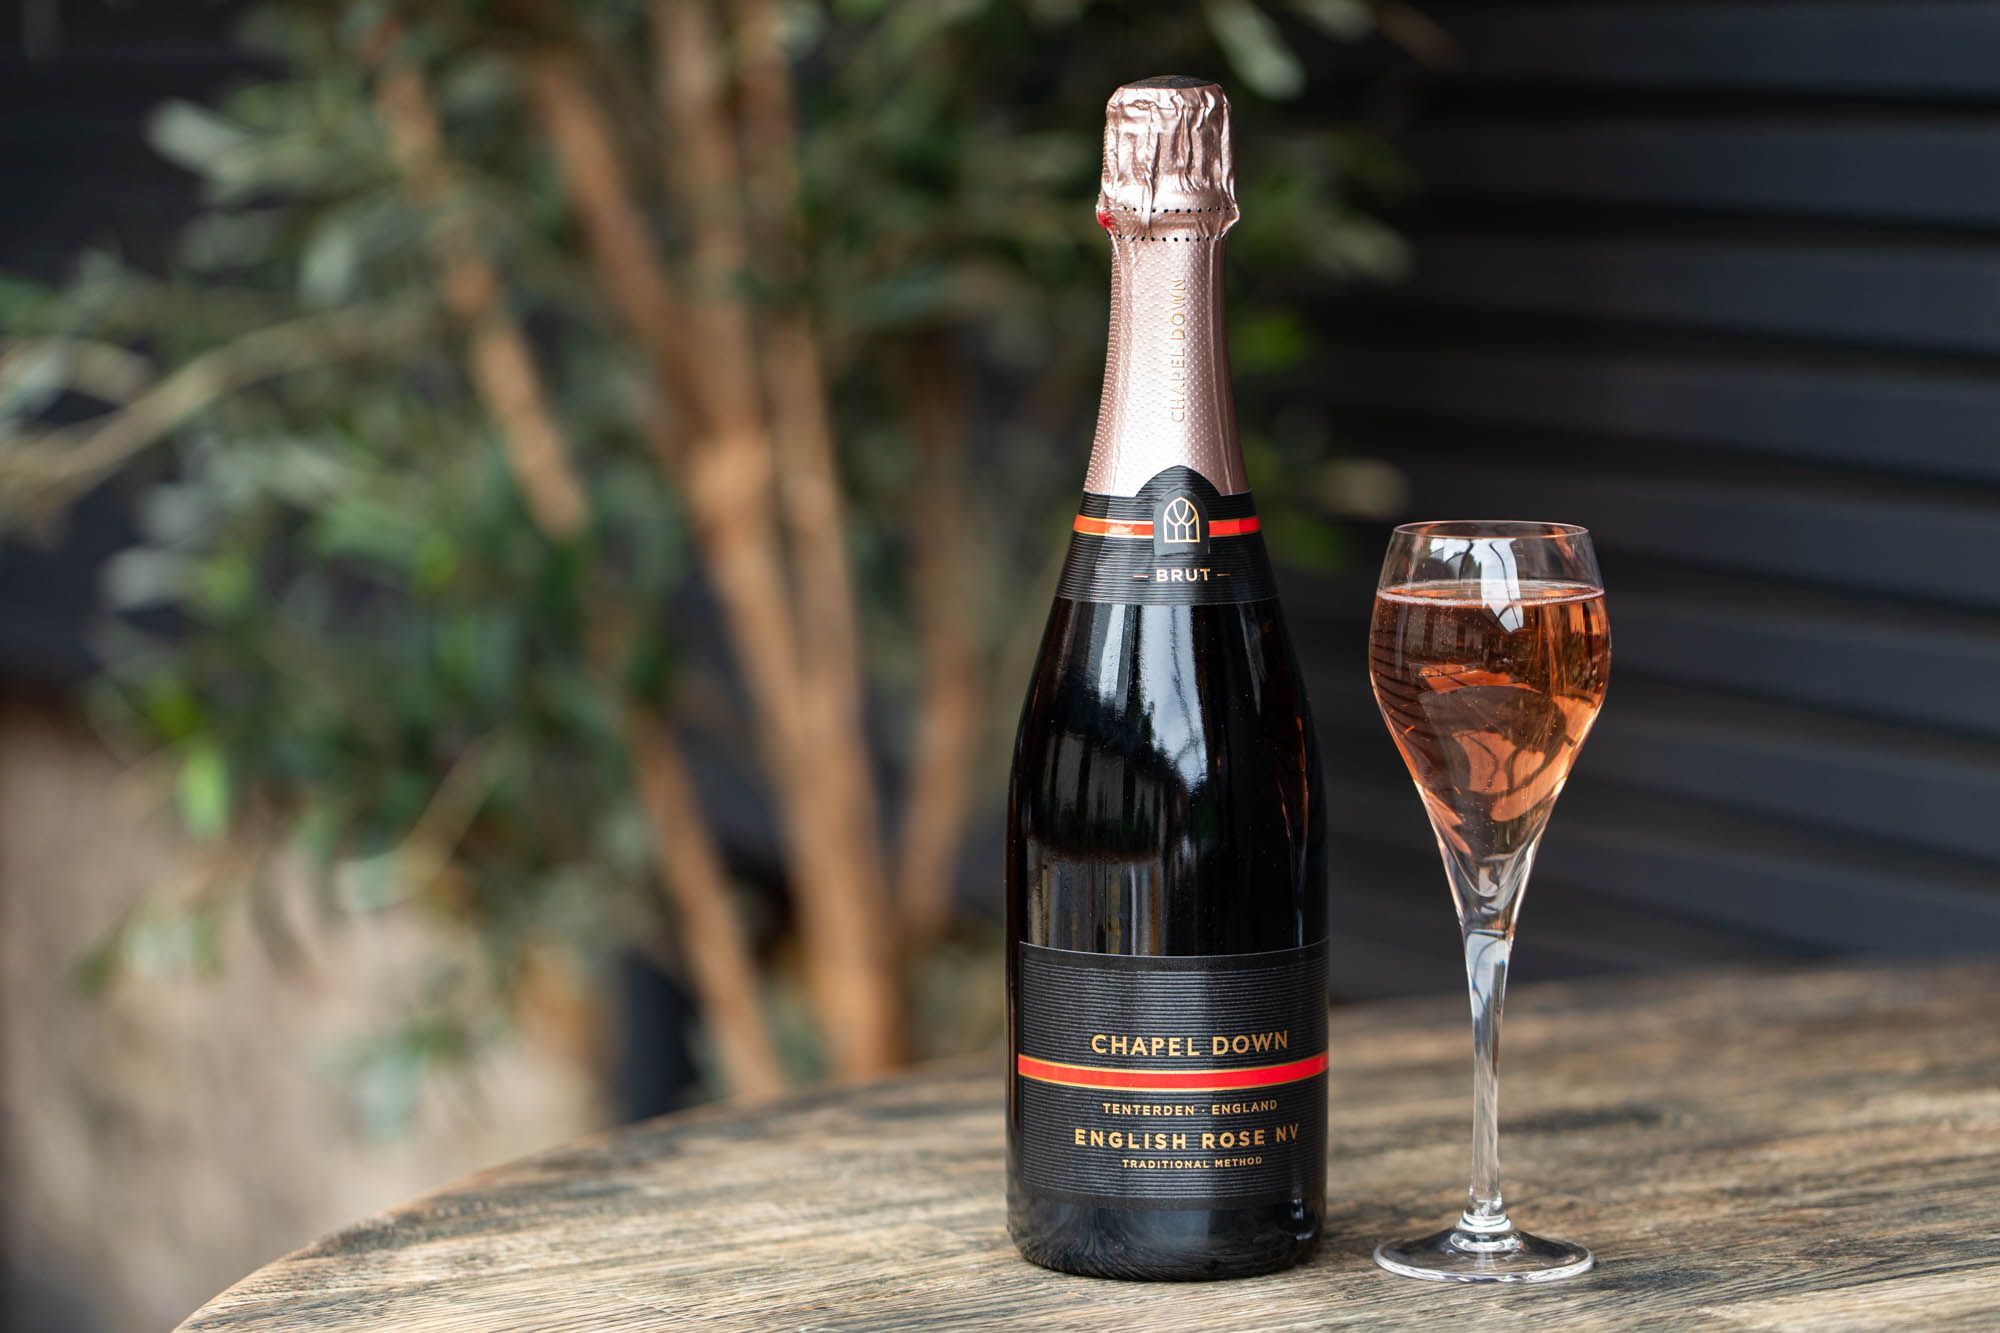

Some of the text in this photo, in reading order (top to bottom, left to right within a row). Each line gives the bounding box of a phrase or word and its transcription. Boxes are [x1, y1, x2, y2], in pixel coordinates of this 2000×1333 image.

[1170, 278, 1185, 341] DOWN
[1155, 568, 1211, 582] BRUT
[1091, 1030, 1288, 1056] CHAPEL DOWN
[1103, 1100, 1278, 1116] TENTERDEN ENGLAND
[1074, 1123, 1299, 1150] ENGLISH ROSE NV
[1121, 1156, 1263, 1169] TRADITIONAL METHOD
